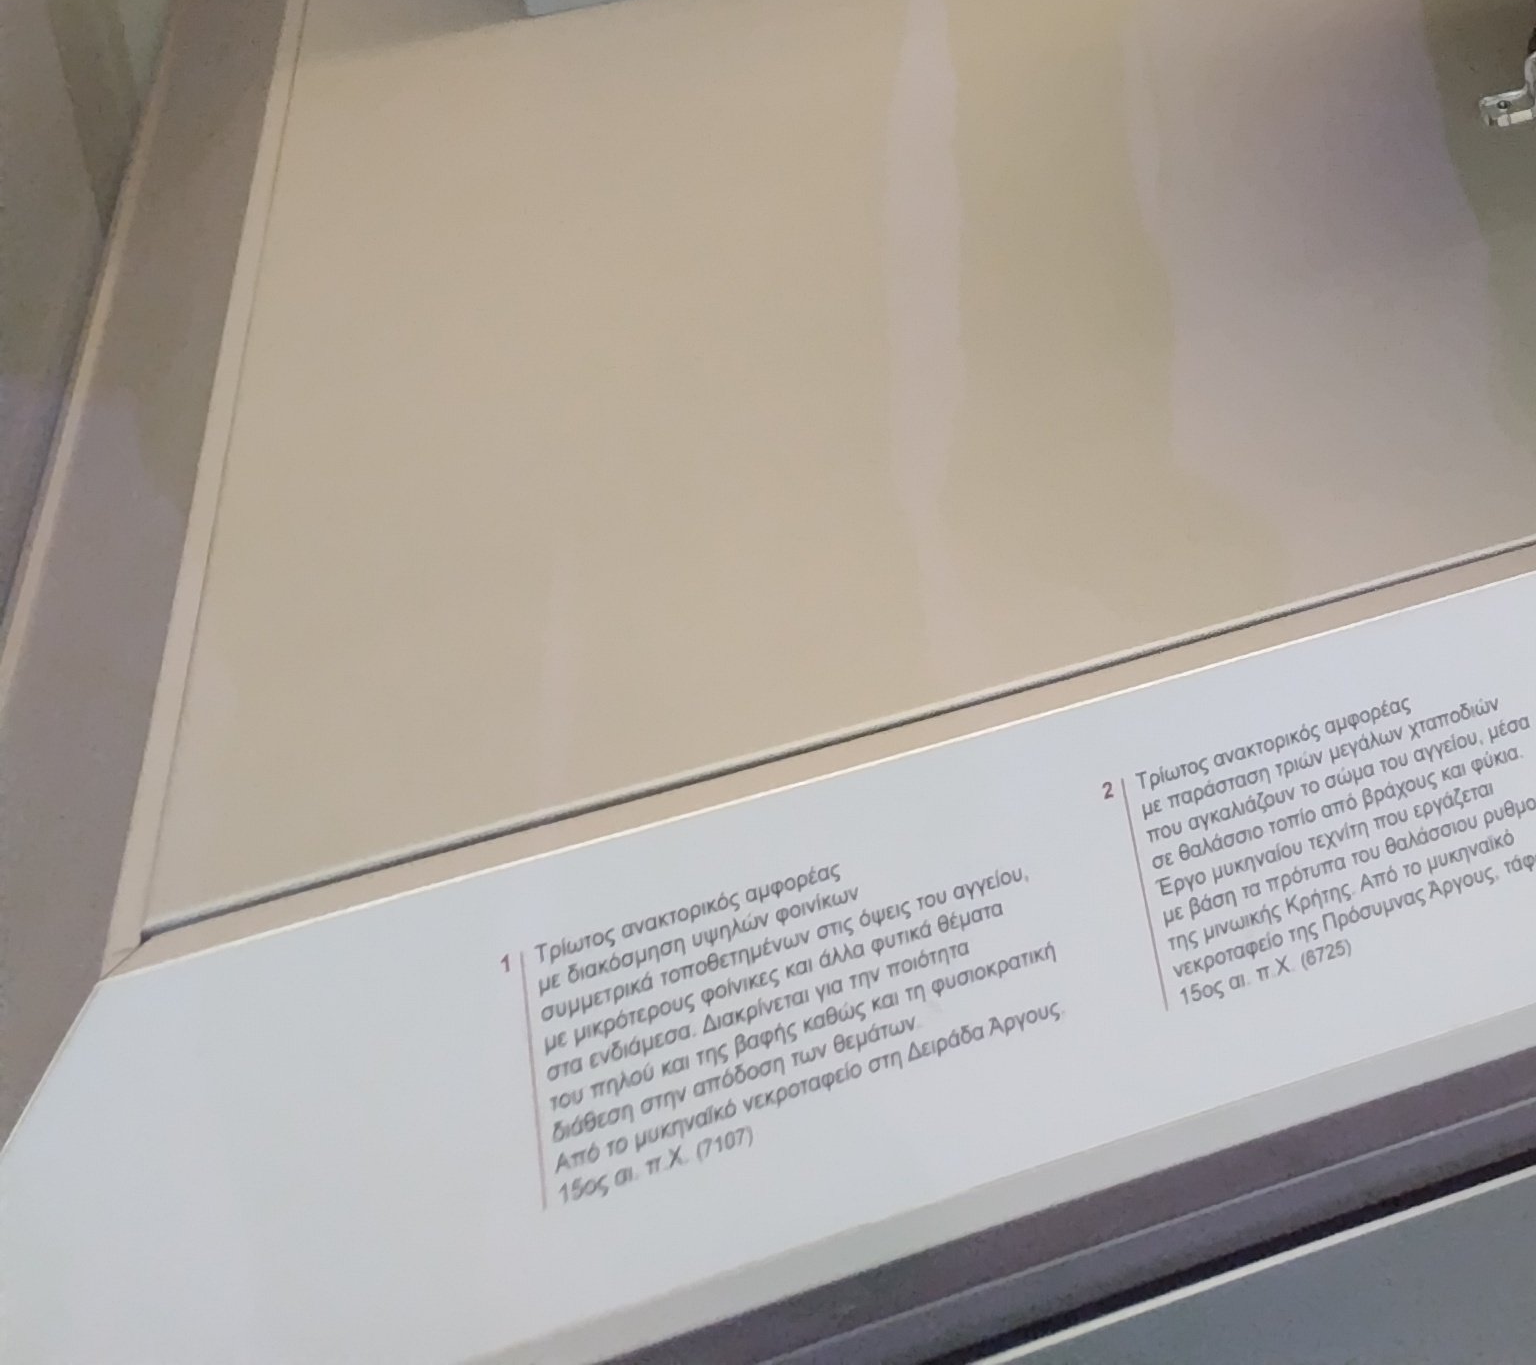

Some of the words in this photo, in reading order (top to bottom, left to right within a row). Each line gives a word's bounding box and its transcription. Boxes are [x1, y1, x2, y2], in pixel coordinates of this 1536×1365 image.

[1102, 781, 1114, 800] 2
[1135, 757, 1210, 791] Τρίωτος
[1213, 723, 1321, 767] ανακτορικός
[1324, 697, 1412, 736] αμφορέας
[1141, 799, 1163, 821] με
[1166, 767, 1272, 808] παράσταση
[1274, 750, 1323, 779] τριών
[1329, 726, 1403, 765] μεγάλων
[1408, 697, 1499, 741] χταποδιών
[1146, 821, 1183, 843] που
[1188, 787, 1295, 831] αγκαλιάζουν
[1300, 780, 1320, 796] το
[1324, 763, 1376, 789] σώμα
[1379, 752, 1408, 773] του
[1487, 716, 1531, 744] μέσα
[1152, 852, 1174, 870] σε
[1178, 825, 1264, 861] θαλάσσιο
[1268, 807, 1316, 834] τοπίο
[1321, 792, 1358, 819] από
[1361, 771, 1438, 811] βράχους
[1441, 763, 1467, 781] και
[1154, 871, 1207, 897] Έργο
[1211, 841, 1303, 885] μυκηναίου
[1308, 821, 1370, 851] τεχνίτη
[1372, 809, 1408, 830] που
[1413, 782, 1494, 820] εργάζεται
[534, 927, 616, 965] Τρίωτος
[621, 891, 741, 939] ανακτορικός
[745, 863, 841, 904] αμφορέας
[1163, 906, 1184, 929] με
[1188, 890, 1238, 921] βάση
[1241, 882, 1262, 899] τα
[1265, 856, 1347, 892] πρότυπα
[1351, 845, 1381, 865] του
[1384, 815, 1478, 855] θαλάσσιου
[1167, 930, 1199, 951] της
[1203, 903, 1282, 945] μινωικής
[1360, 865, 1398, 892] Από
[1402, 861, 1422, 878] το
[1426, 828, 1515, 875] μυκηναϊκό
[501, 953, 510, 973] 1
[538, 973, 561, 997] με
[567, 937, 686, 984] διακόσμηση
[692, 912, 769, 948] υψηλών
[775, 886, 859, 927] φοινίκων
[541, 971, 654, 1022] συμμετρικά
[816, 917, 854, 940] στις
[859, 900, 912, 927] όψεις
[916, 890, 947, 911] του
[544, 1031, 568, 1056] με
[574, 992, 695, 1048] μικρότερους
[700, 968, 780, 1008] φοίνικες
[785, 958, 813, 979] και
[819, 943, 865, 969] άλλα
[871, 919, 932, 957] φυτικά
[937, 903, 1004, 933] θέματα
[1172, 931, 1284, 978] νεκροταφείο
[1288, 921, 1319, 943] της
[1322, 888, 1427, 932] Πρόσυμνας
[1179, 980, 1225, 1005] 15ος
[552, 1103, 635, 1143] διάθεση
[640, 1086, 687, 1115] στην
[693, 1056, 786, 1098] απόδοση
[791, 1043, 827, 1067] των
